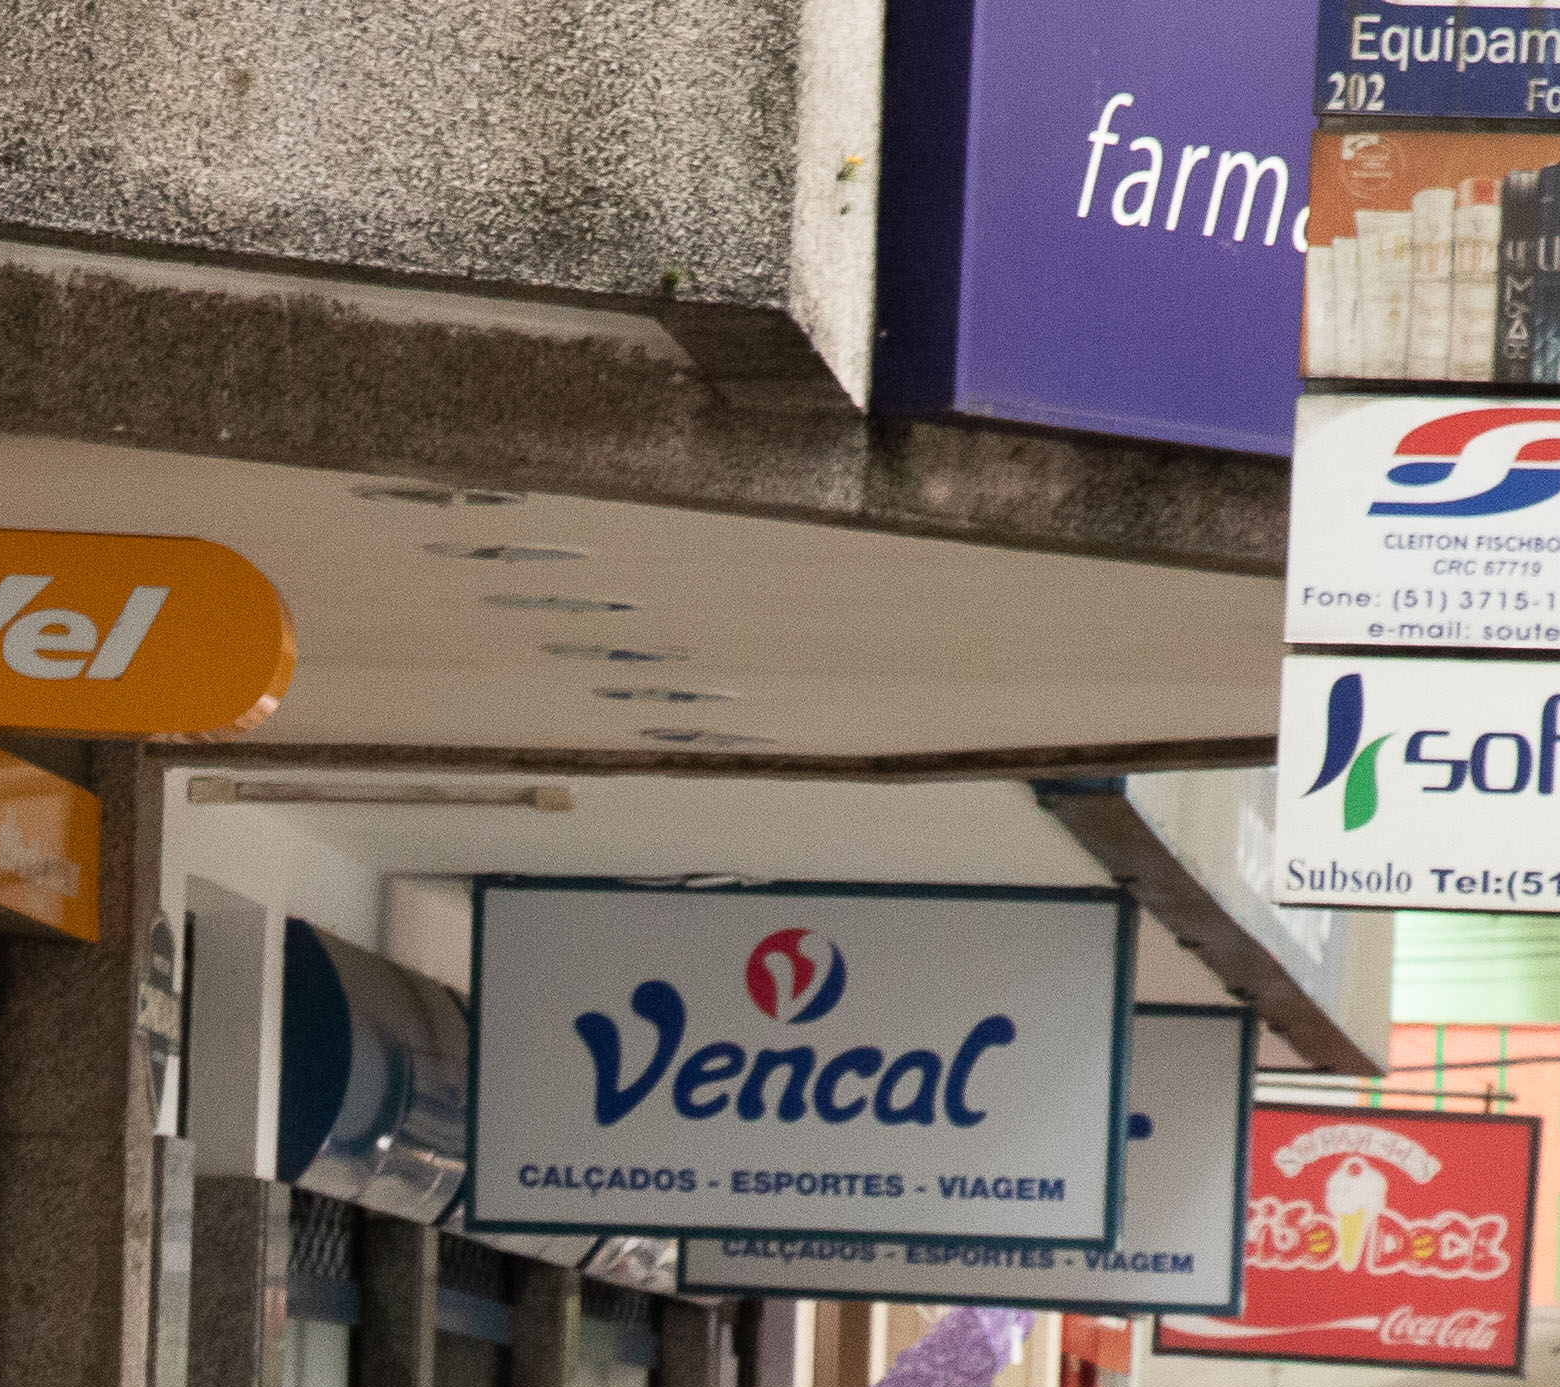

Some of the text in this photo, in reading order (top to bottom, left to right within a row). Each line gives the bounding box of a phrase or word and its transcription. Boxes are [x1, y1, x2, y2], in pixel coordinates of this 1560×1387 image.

[1327, 73, 1386, 112] 202
[1383, 533, 1468, 551] CLEITON
[1432, 558, 1477, 576] CRC
[1302, 586, 1381, 608] Fone:
[1392, 589, 1448, 613] (51)
[1367, 620, 1474, 640] e-mail:
[1285, 858, 1412, 895] Subsolo
[573, 978, 1016, 1129] Vencal
[518, 1165, 1066, 1203] CALÇADOS ESPORTES VIAGEM
[905, 1242, 1054, 1270] ESPORTES
[1084, 1249, 1195, 1274] VIAGEM
